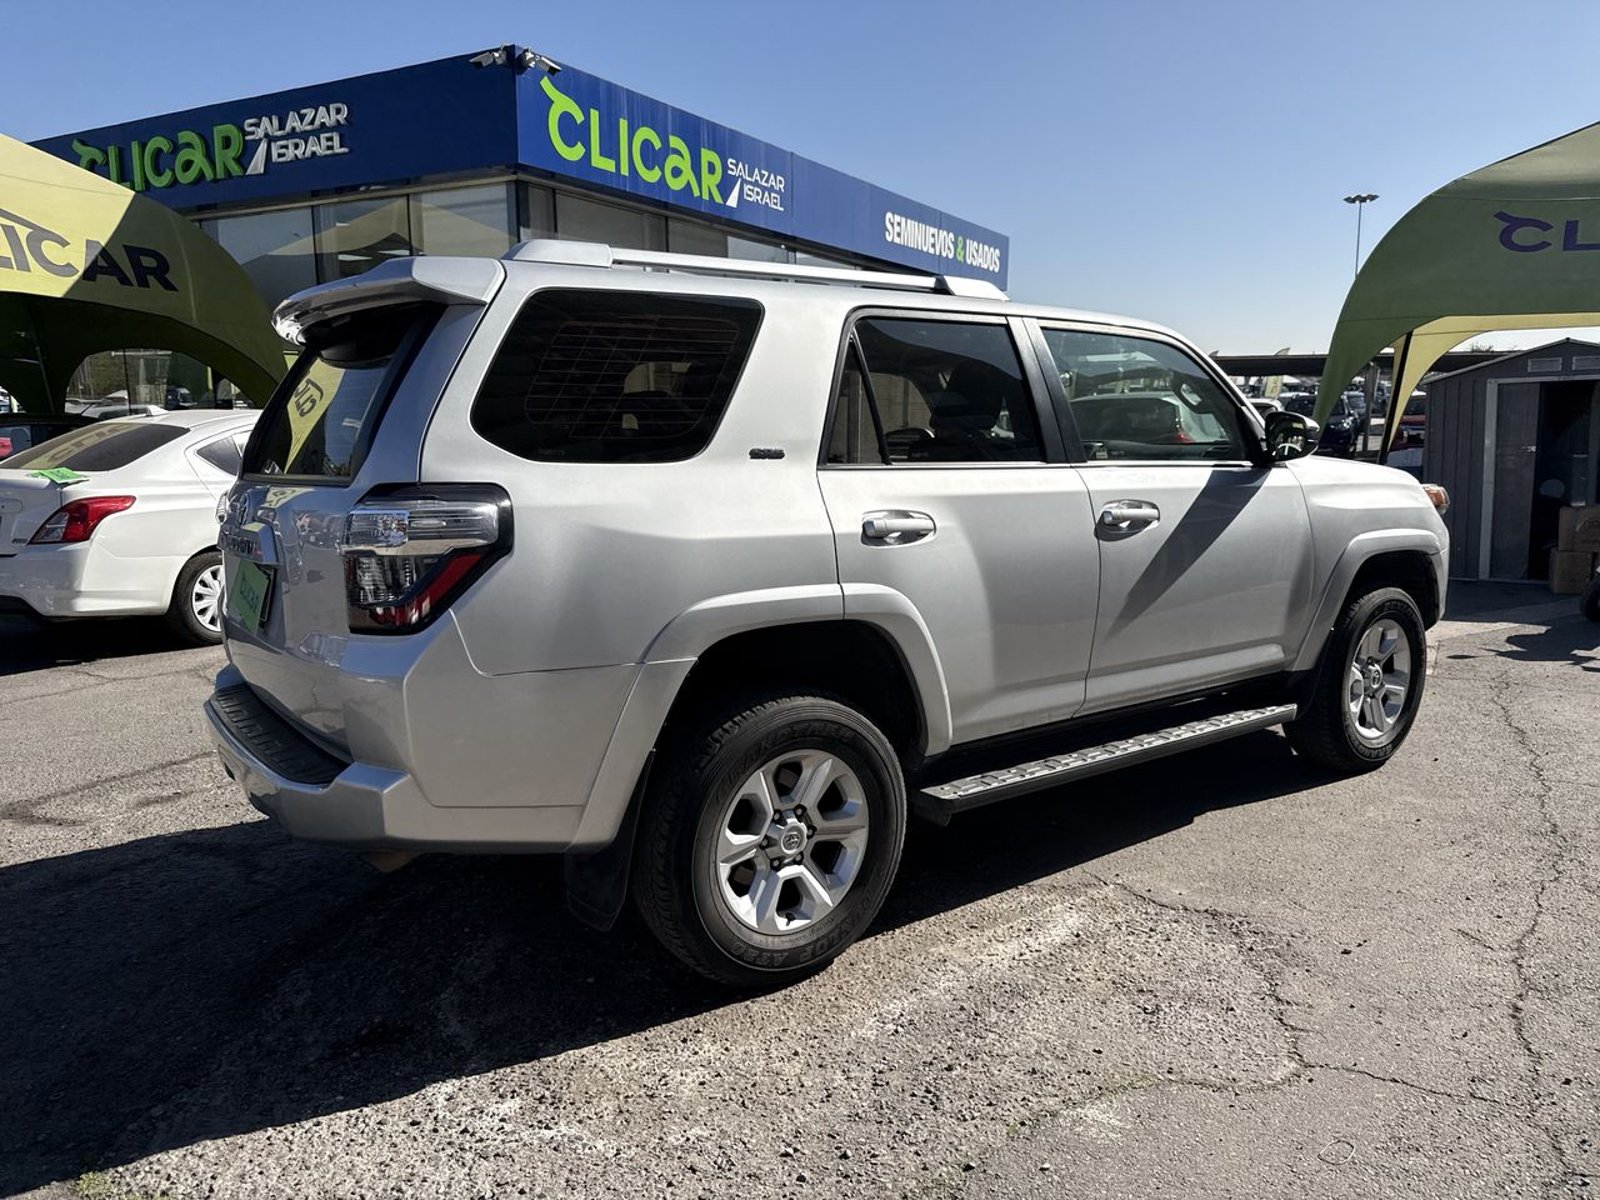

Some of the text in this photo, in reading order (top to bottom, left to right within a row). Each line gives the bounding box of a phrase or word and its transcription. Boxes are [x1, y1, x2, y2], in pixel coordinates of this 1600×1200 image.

[244, 103, 348, 140] SALAZAR
[271, 131, 349, 163] ISRAEL
[727, 158, 785, 192] SALAZAR
[743, 184, 784, 211] ISRAEL
[885, 211, 1000, 273] SEMINUEVOS & USADOS
